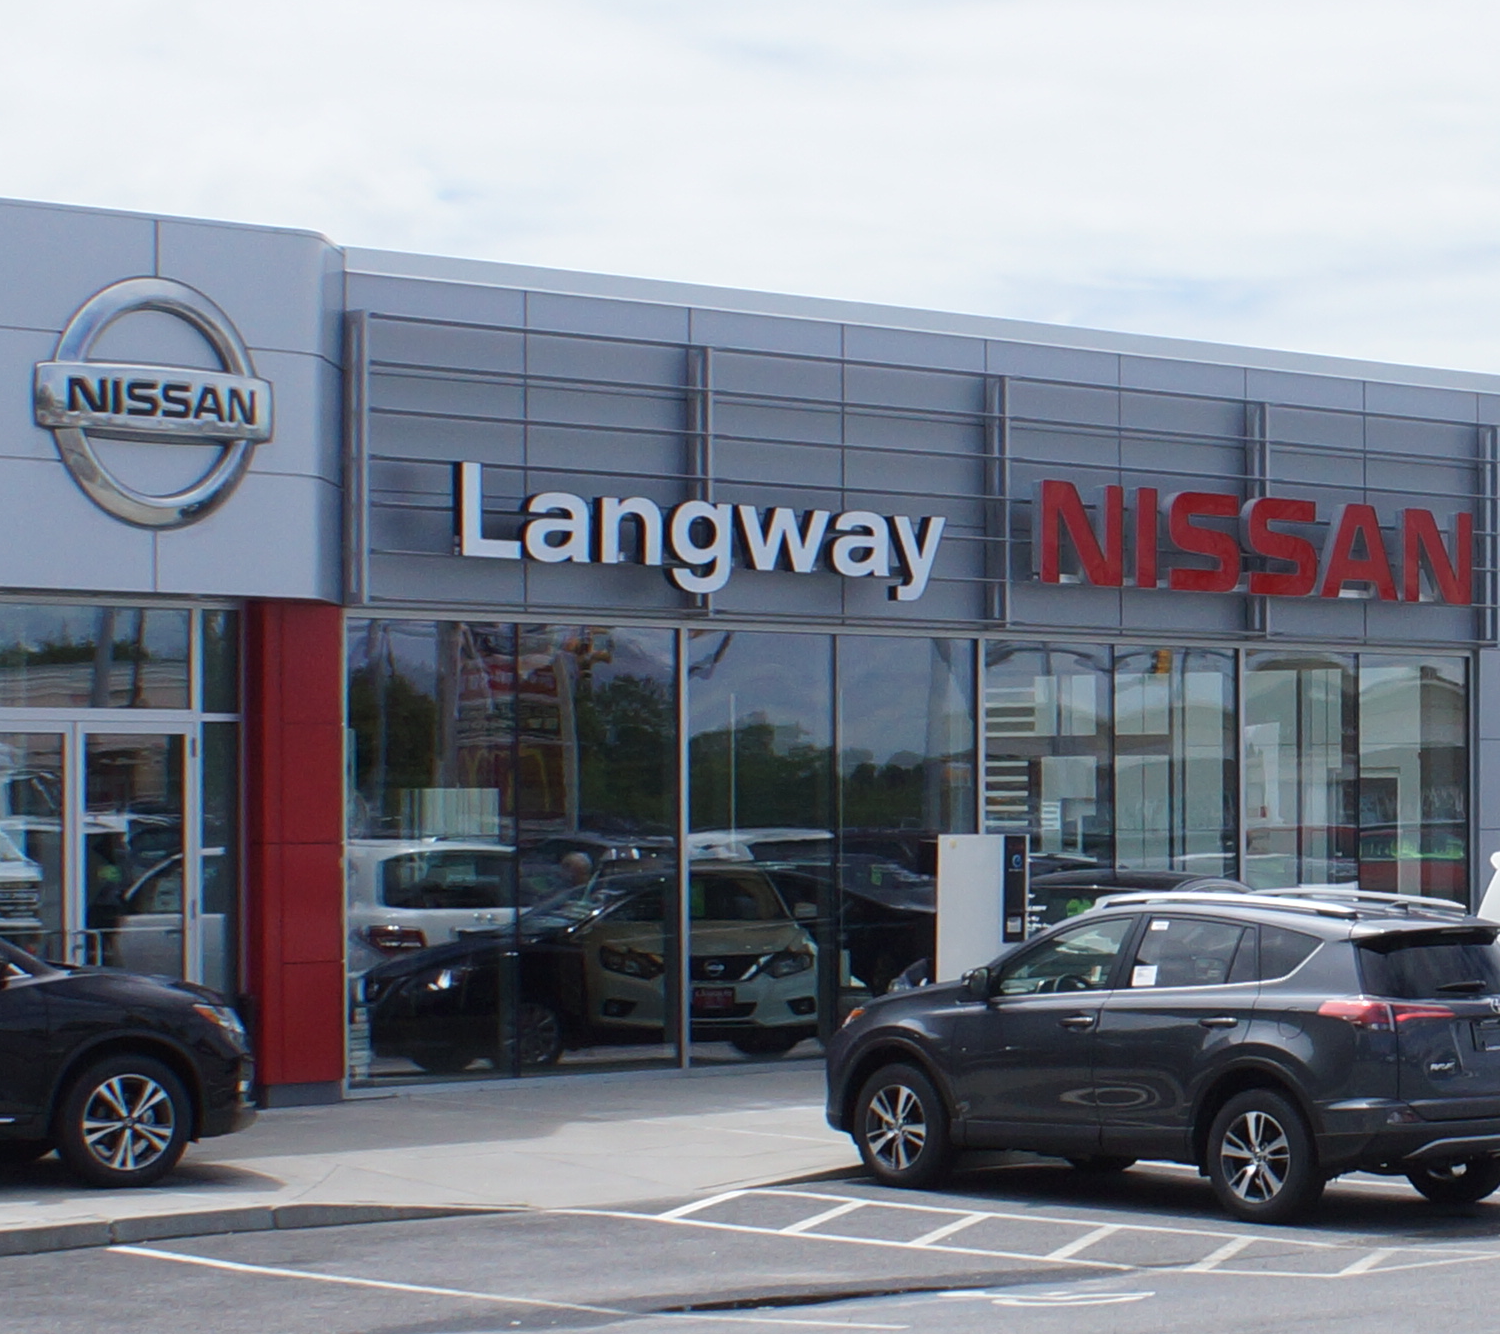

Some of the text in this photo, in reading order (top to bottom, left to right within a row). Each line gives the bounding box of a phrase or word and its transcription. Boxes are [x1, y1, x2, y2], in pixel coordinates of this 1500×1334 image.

[66, 375, 258, 426] NISSAN
[454, 461, 1473, 606] Langway NISSAN
